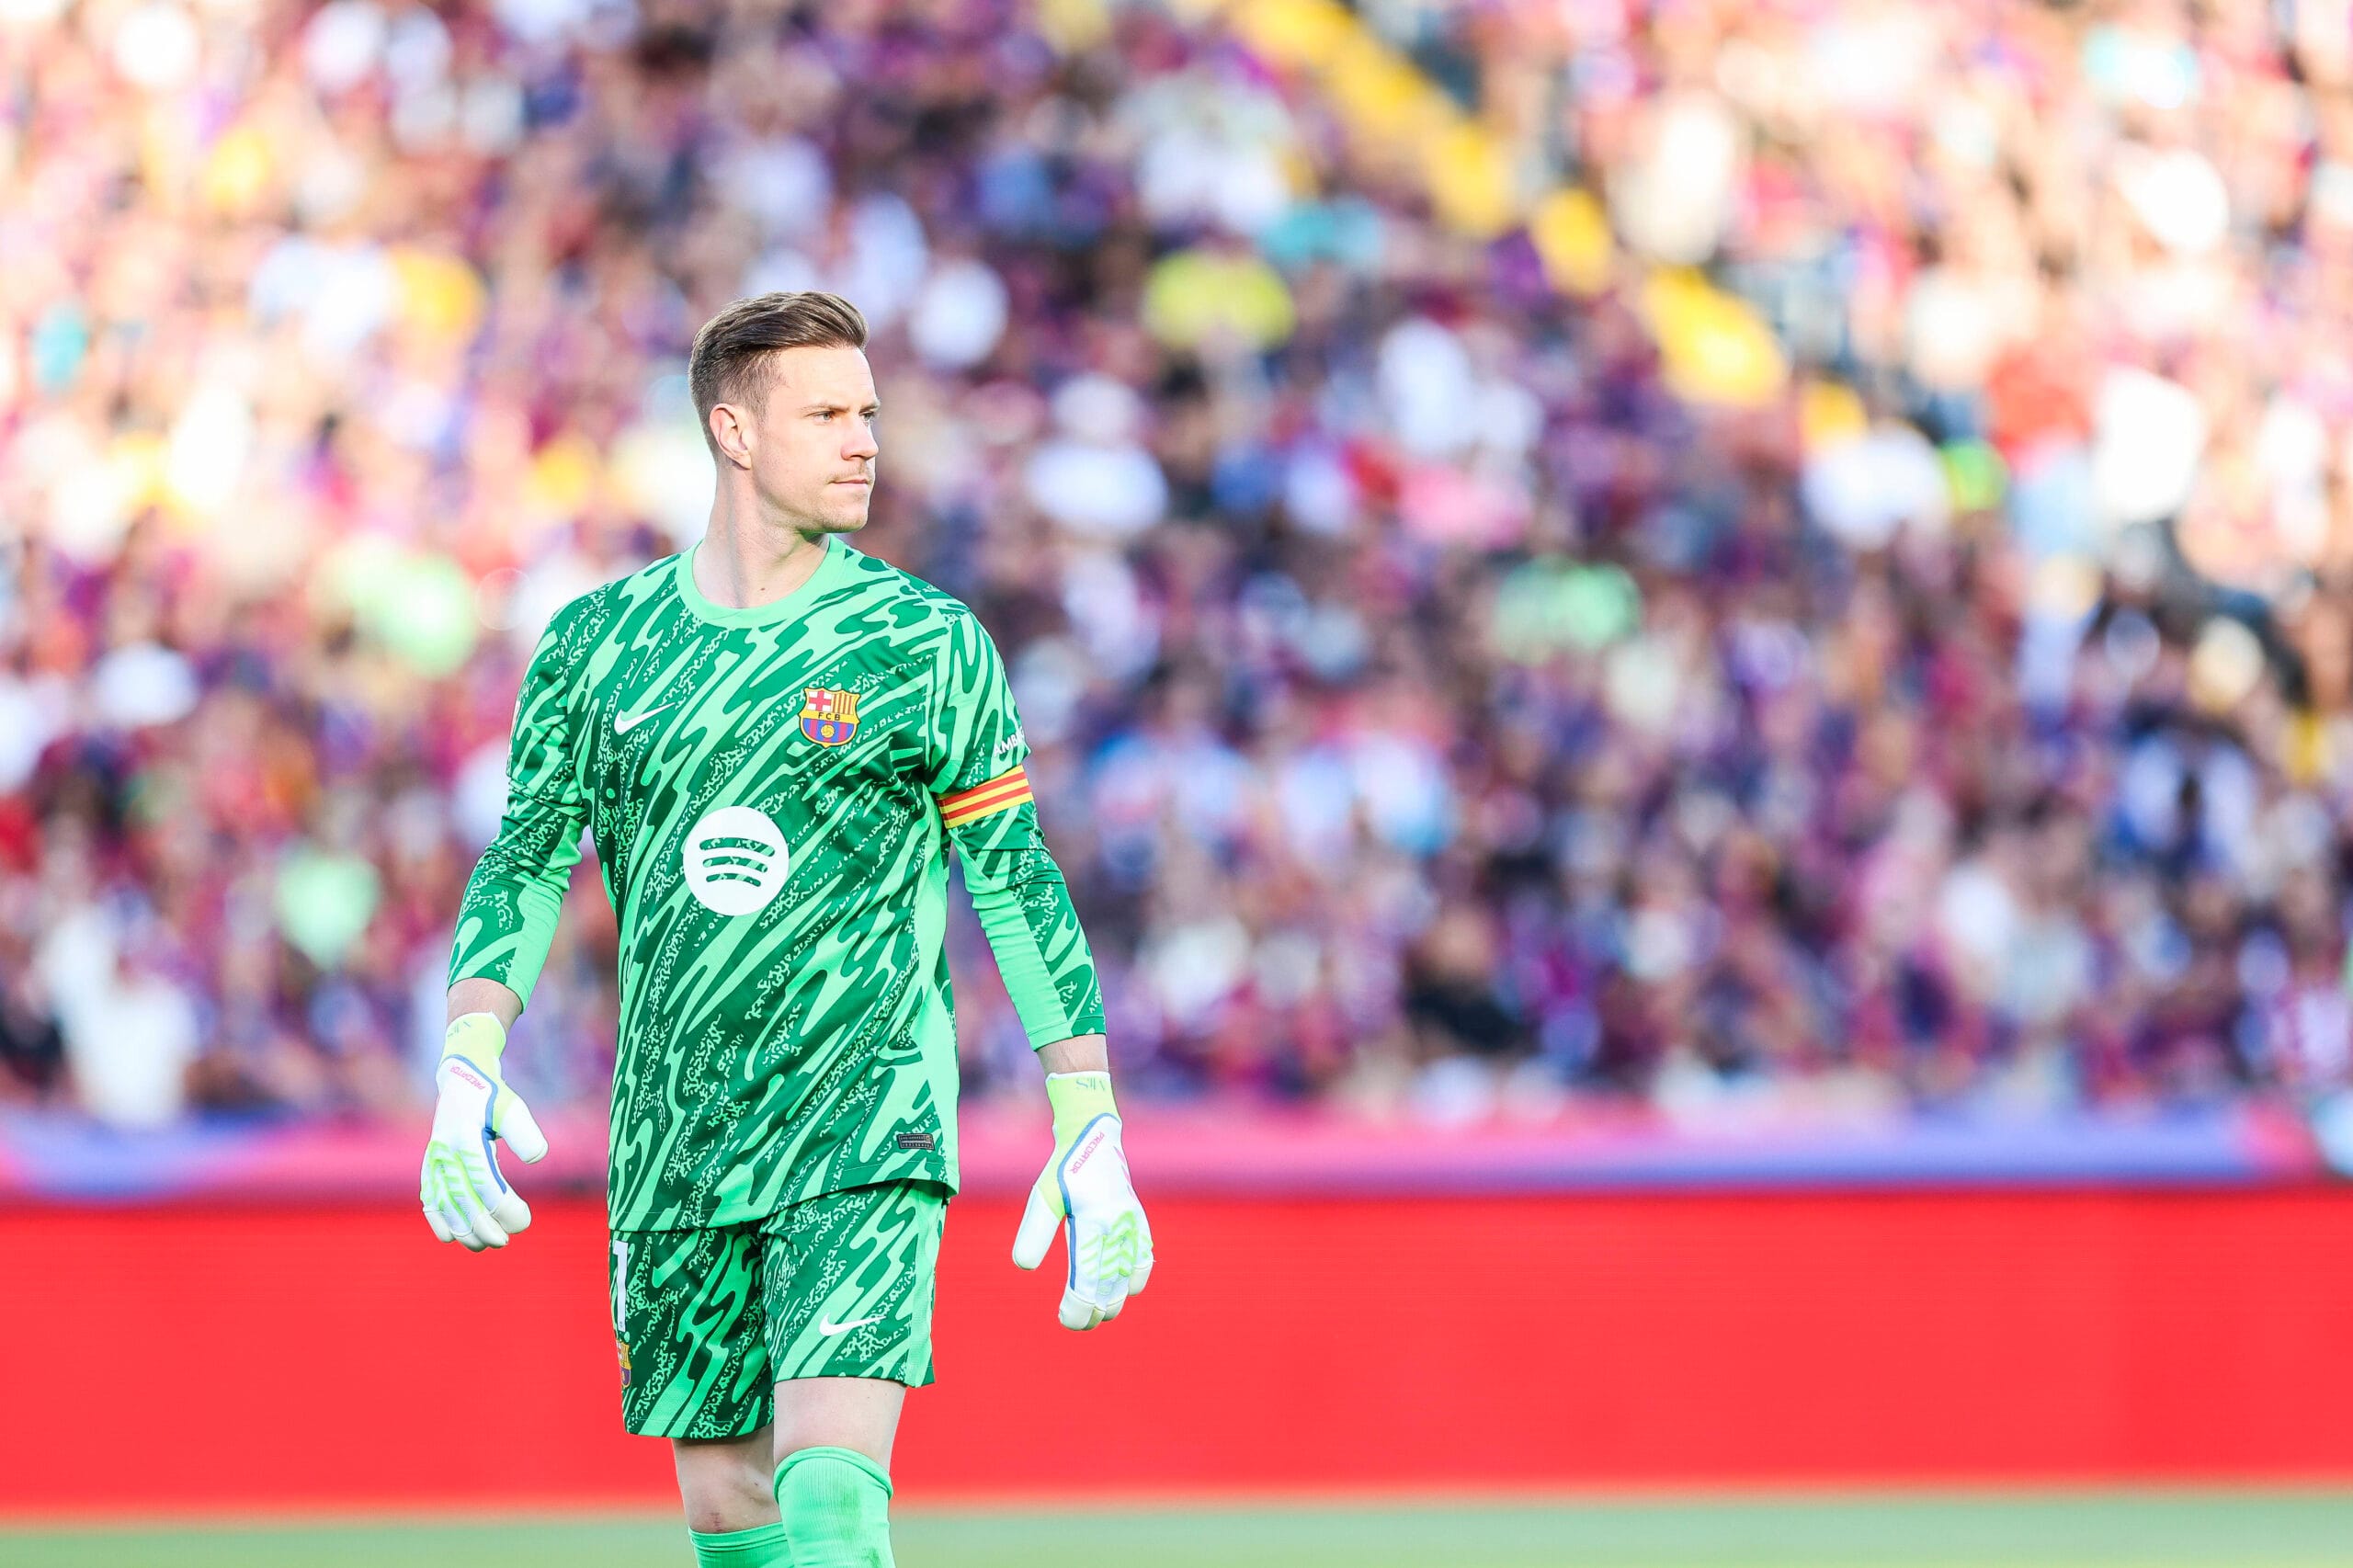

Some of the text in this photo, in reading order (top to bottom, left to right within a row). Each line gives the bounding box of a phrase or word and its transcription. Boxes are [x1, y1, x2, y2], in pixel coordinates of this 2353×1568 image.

[817, 712, 841, 722] FCB
[1070, 1131, 1106, 1175] PREDATOR
[612, 1241, 629, 1333] 1
